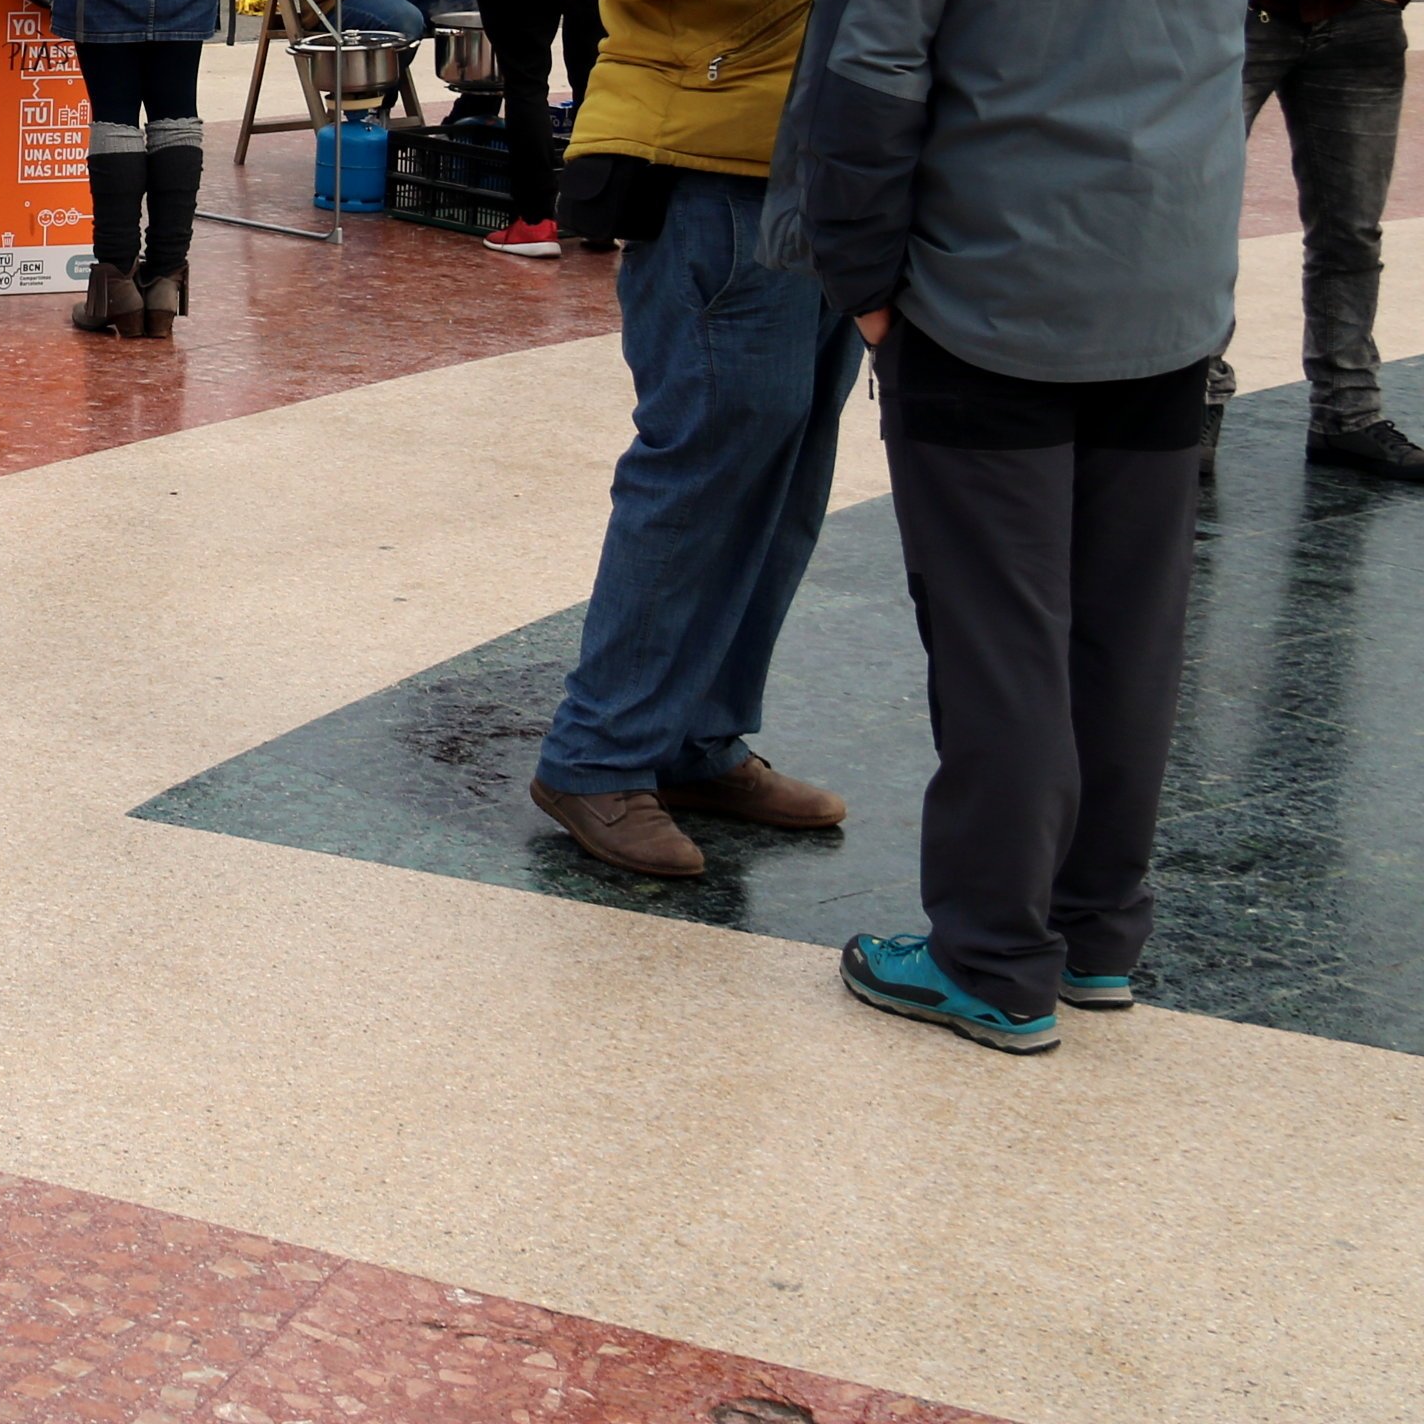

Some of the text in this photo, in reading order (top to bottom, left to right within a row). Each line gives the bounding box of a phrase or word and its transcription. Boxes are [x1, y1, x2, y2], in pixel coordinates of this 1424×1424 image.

[12, 19, 36, 36] YO
[29, 46, 47, 58] NO
[28, 59, 45, 72] LA
[23, 101, 48, 124] TÚ
[24, 132, 82, 145] VIVES EN
[24, 149, 52, 161] UNA
[23, 161, 52, 177] MÁS
[22, 263, 41, 272] BCN
